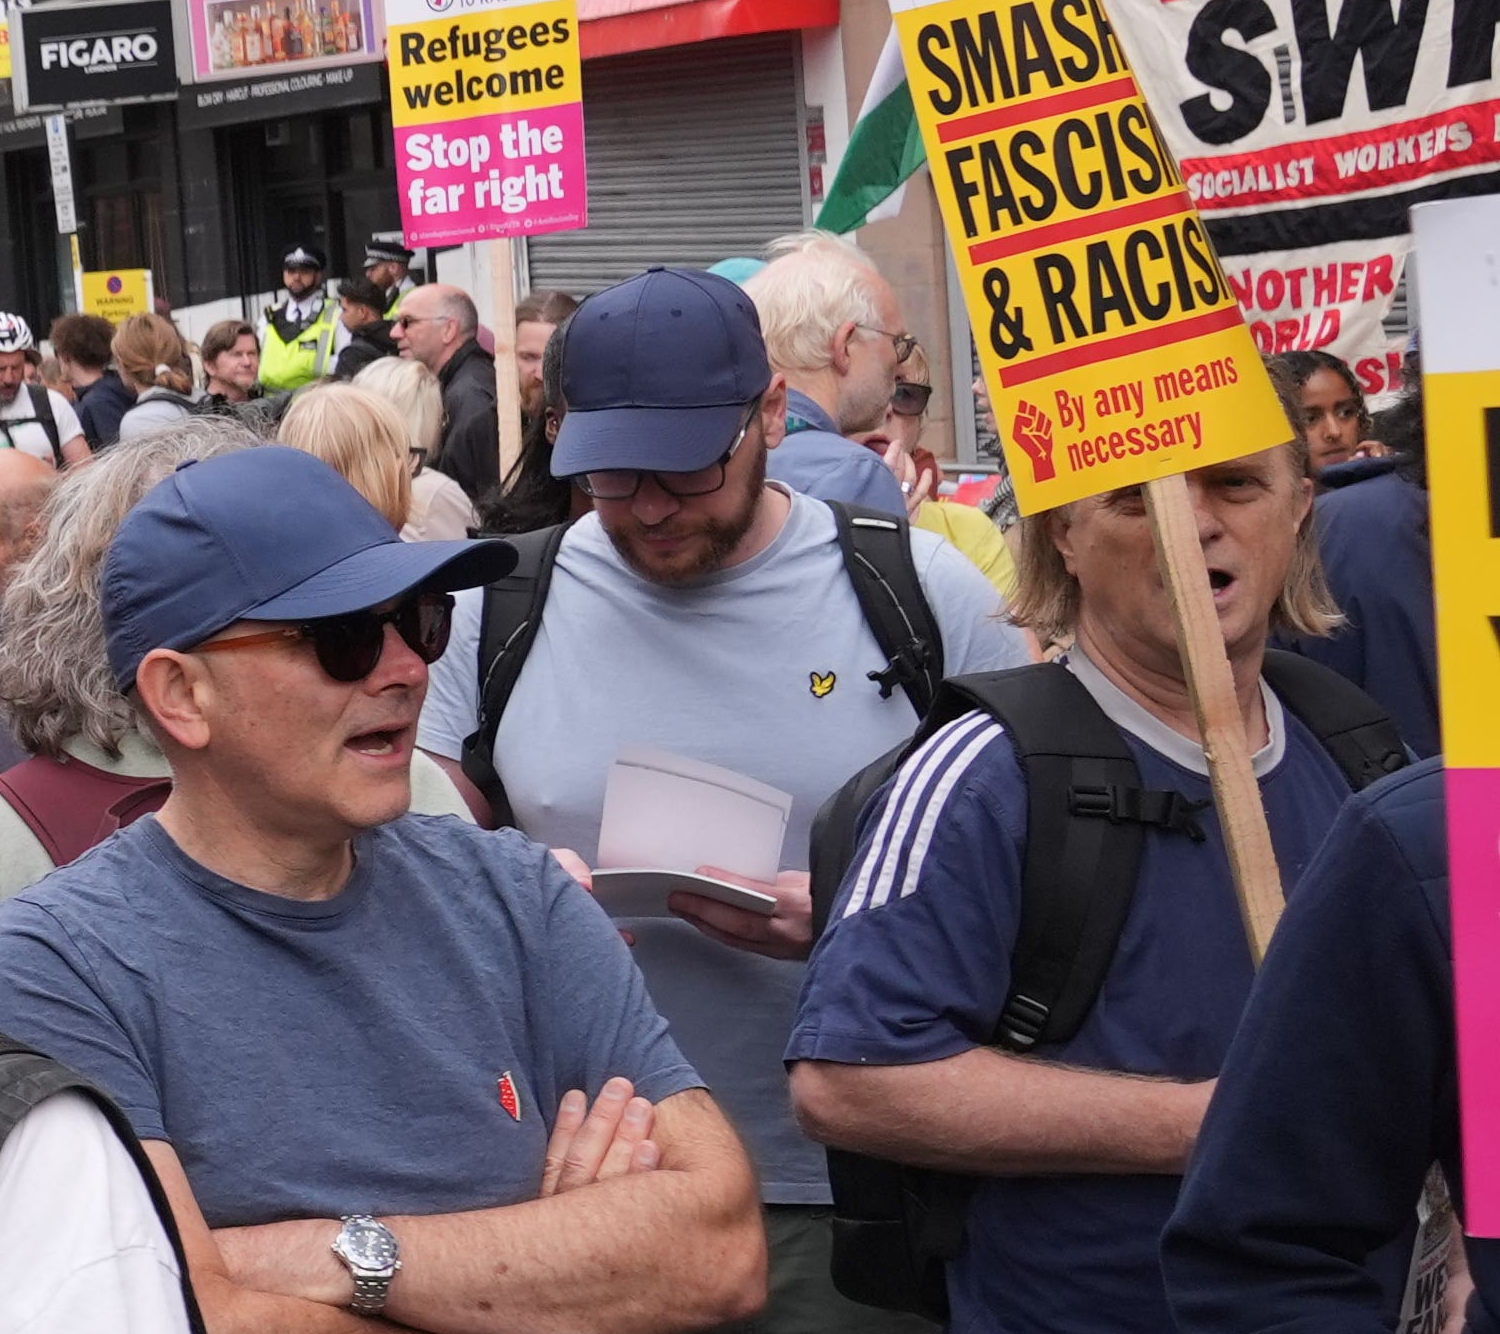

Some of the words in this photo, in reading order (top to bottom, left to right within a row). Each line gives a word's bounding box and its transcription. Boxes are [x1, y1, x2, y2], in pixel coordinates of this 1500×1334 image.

[40, 34, 157, 70] FIGARO
[400, 18, 570, 66] Refugees
[403, 64, 564, 109] welcome
[406, 133, 490, 172] Stop
[500, 120, 563, 159] the
[1186, 156, 1315, 200] SOCIALIST
[1334, 122, 1472, 179] WORKERS
[408, 179, 464, 216] far
[474, 164, 564, 213] right
[1228, 254, 1394, 311] NOTHER
[982, 267, 1033, 359] &
[1055, 388, 1085, 432] By
[1094, 379, 1144, 424] any
[1154, 356, 1238, 402] means
[1067, 410, 1203, 472] necessary
